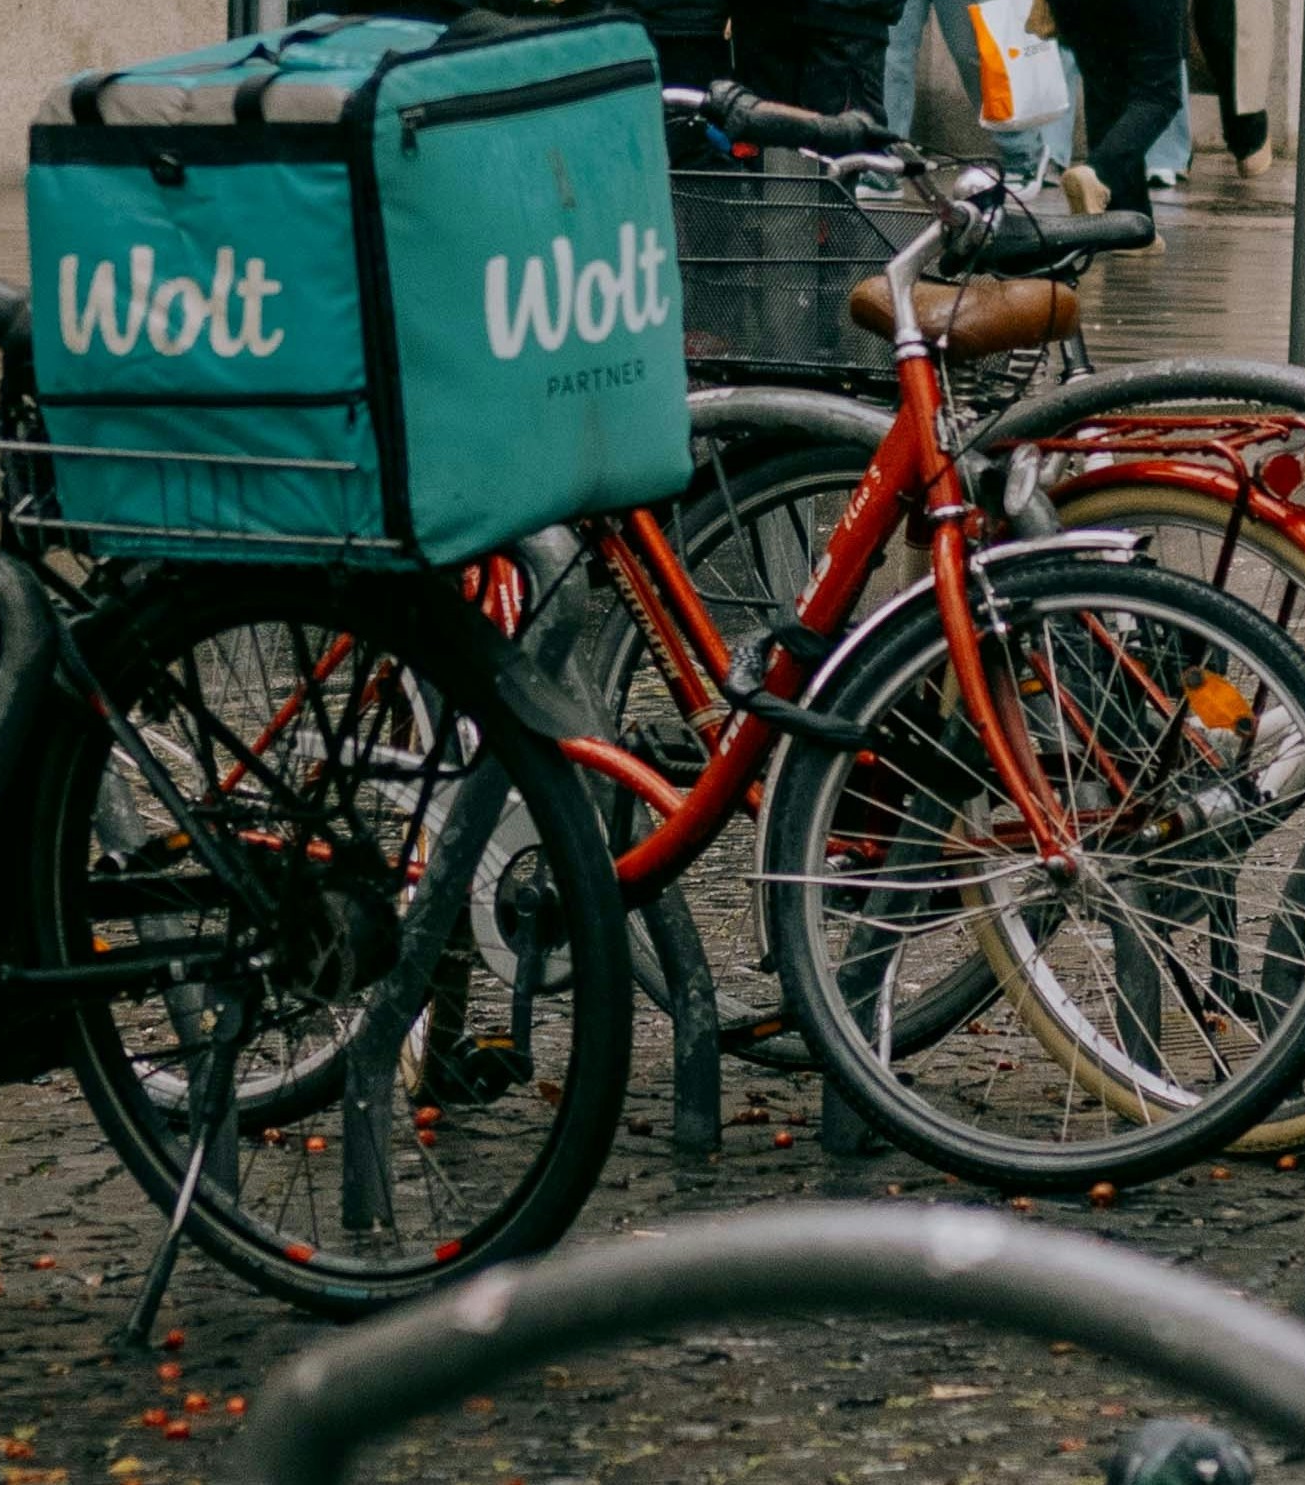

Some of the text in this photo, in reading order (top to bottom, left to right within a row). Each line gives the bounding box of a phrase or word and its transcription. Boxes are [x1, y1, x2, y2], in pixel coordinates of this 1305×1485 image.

[58, 243, 285, 359] Wolt
[484, 221, 671, 361] Wolt
[545, 358, 648, 400] PARTNER
[606, 555, 683, 681] TRIUMPH
